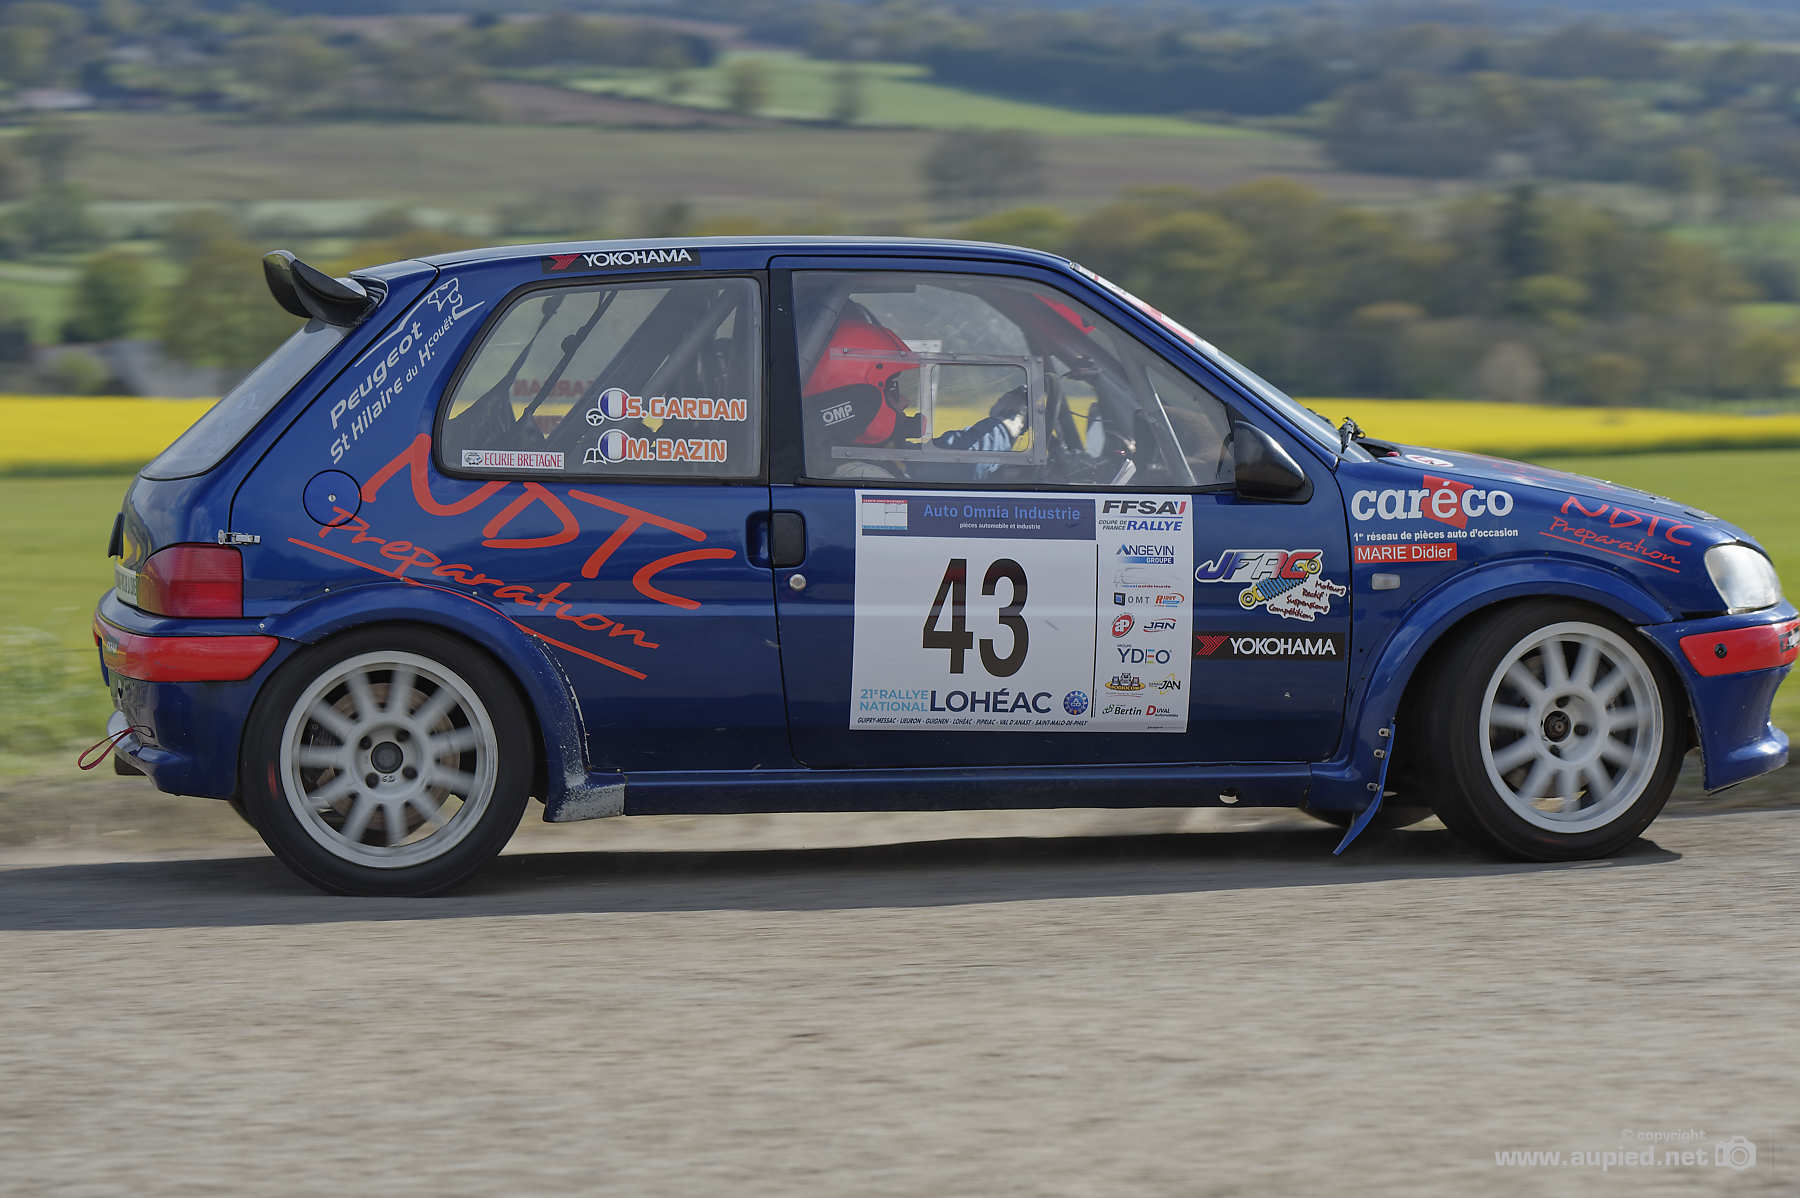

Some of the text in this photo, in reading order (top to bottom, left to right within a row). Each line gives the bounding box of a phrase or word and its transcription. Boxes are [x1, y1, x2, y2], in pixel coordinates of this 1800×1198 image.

[583, 249, 692, 267] YOKOHAMA
[330, 321, 423, 430] Peugeot
[330, 432, 351, 465] St
[351, 378, 403, 441] Hilaire
[405, 365, 418, 383] du
[822, 402, 854, 424] OMP
[484, 452, 563, 468] ECURIE BRETAGNE
[1102, 500, 1178, 515] FFSA
[1351, 481, 1514, 521] caréco
[923, 503, 1081, 520] Auto Omnia Industrie
[359, 433, 737, 610] NDTC
[1127, 520, 1183, 531] RALLYE
[1561, 496, 1694, 546] NDTC
[1367, 531, 1398, 542] réseau
[1400, 530, 1412, 540] de
[1414, 529, 1445, 542] pièces
[1447, 529, 1468, 539] auto
[1469, 527, 1519, 538] d'occasion
[1550, 516, 1681, 564] Preparation
[1116, 544, 1174, 556] ANGEVIN
[1357, 545, 1452, 561] MARIE Didier
[317, 507, 660, 649] Preparation
[922, 557, 1030, 678] 43
[1143, 622, 1176, 630] JAN
[1229, 637, 1337, 656] YOKOHAMA
[1117, 648, 1171, 665] YDEO
[1158, 680, 1181, 690] JAN
[880, 689, 929, 700] RALLYE
[930, 688, 1053, 714] LOHÉAC
[859, 701, 929, 712] NATIONAL
[1114, 706, 1142, 716] Bertin
